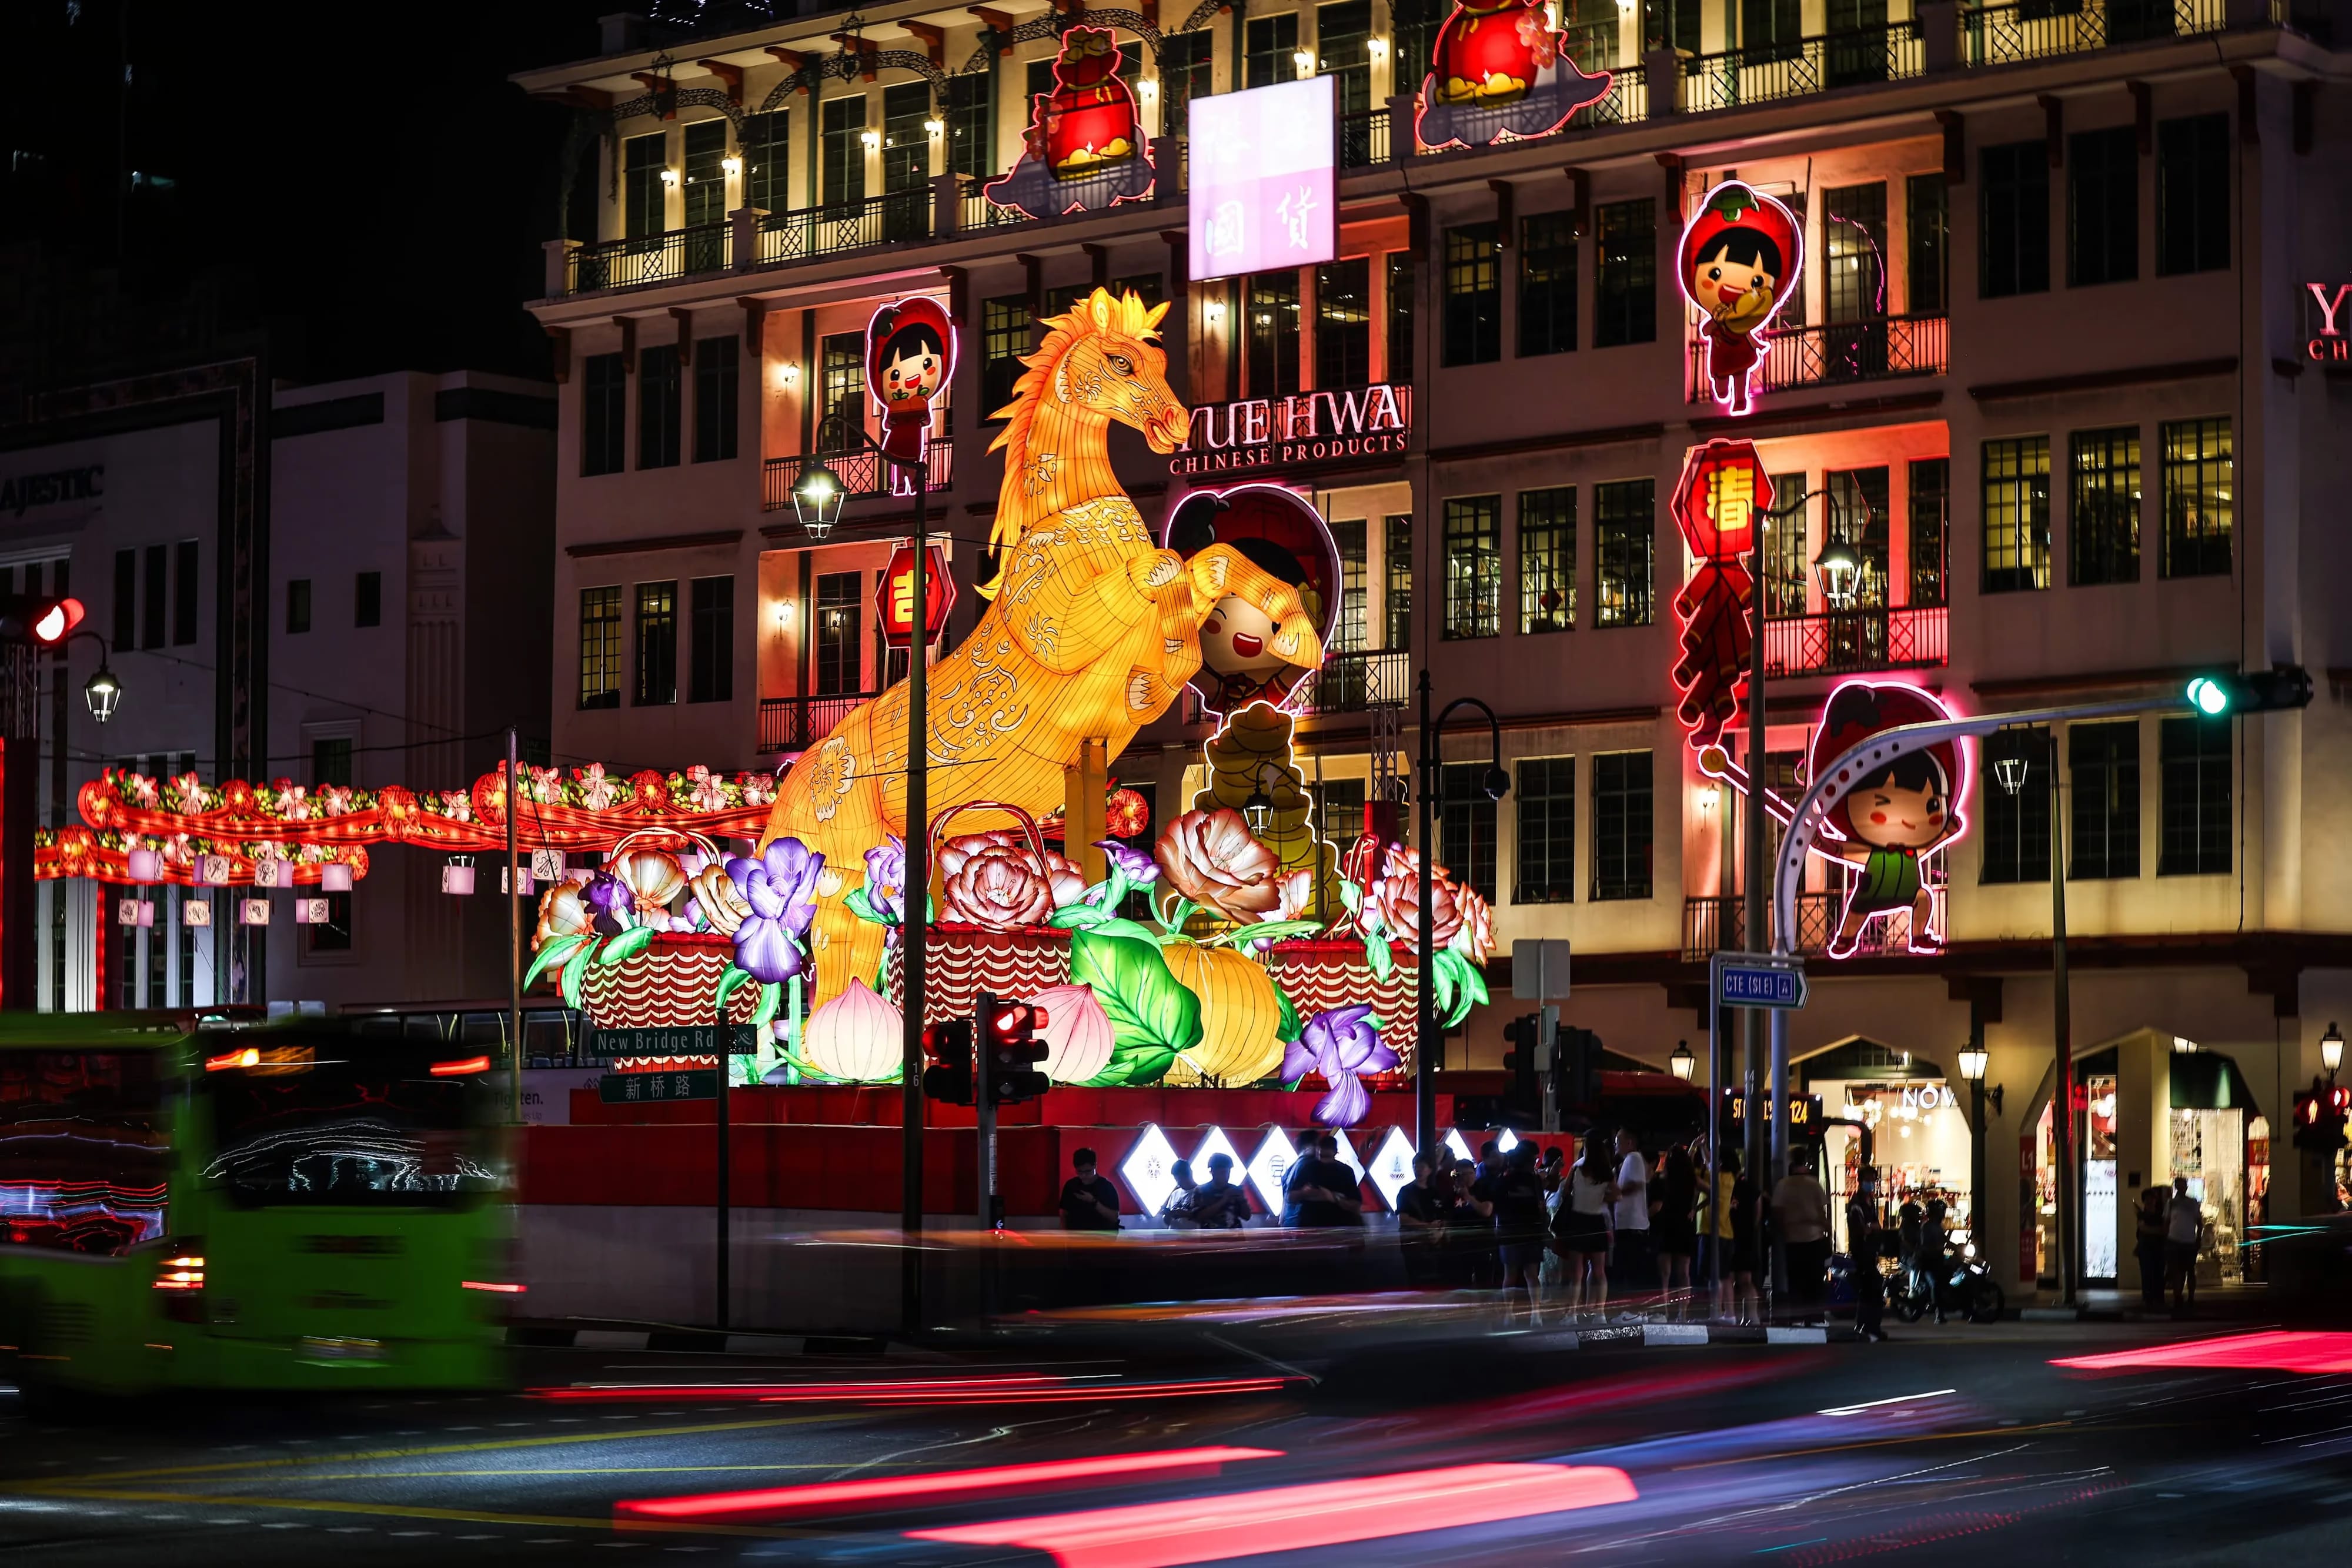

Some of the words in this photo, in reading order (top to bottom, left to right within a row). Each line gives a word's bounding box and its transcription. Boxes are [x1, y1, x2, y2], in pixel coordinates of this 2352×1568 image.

[2308, 339, 2348, 361] CH
[1284, 384, 1405, 440] HWA
[1170, 447, 1270, 474] CHINESE
[1282, 432, 1406, 462] PRODUCTS
[1706, 466, 1753, 531] 春
[1726, 974, 1744, 993] CTE
[597, 1033, 629, 1051] New
[635, 1031, 688, 1053] Bridge
[695, 1029, 714, 1048] Rd
[625, 1074, 690, 1100] 新桥路
[493, 1092, 544, 1109] Tigten.
[1789, 1100, 1808, 1124] 124
